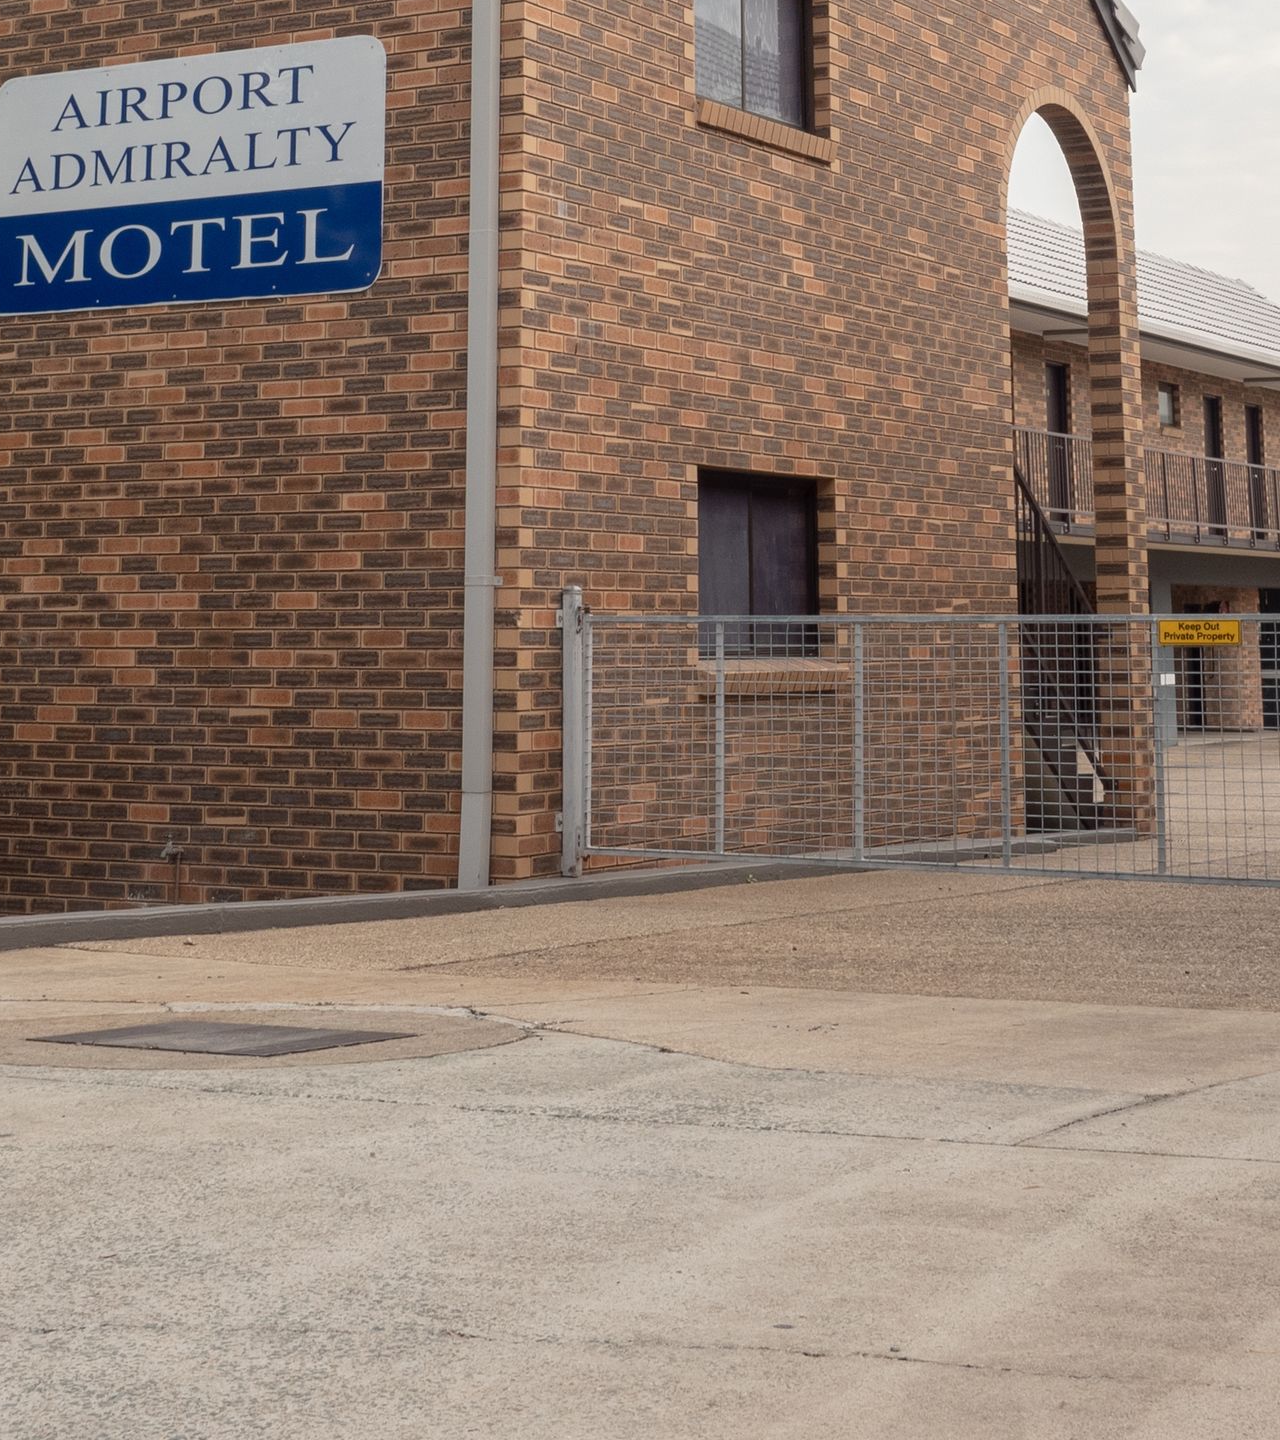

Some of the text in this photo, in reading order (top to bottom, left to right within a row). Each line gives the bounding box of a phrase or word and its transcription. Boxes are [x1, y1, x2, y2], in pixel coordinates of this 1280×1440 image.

[50, 64, 315, 133] AIRPORT
[8, 121, 357, 195] ADMIRALTY
[13, 208, 355, 288] MOTEL
[1164, 632, 1235, 641] Private Property
[1178, 622, 1220, 631] Keep Out
